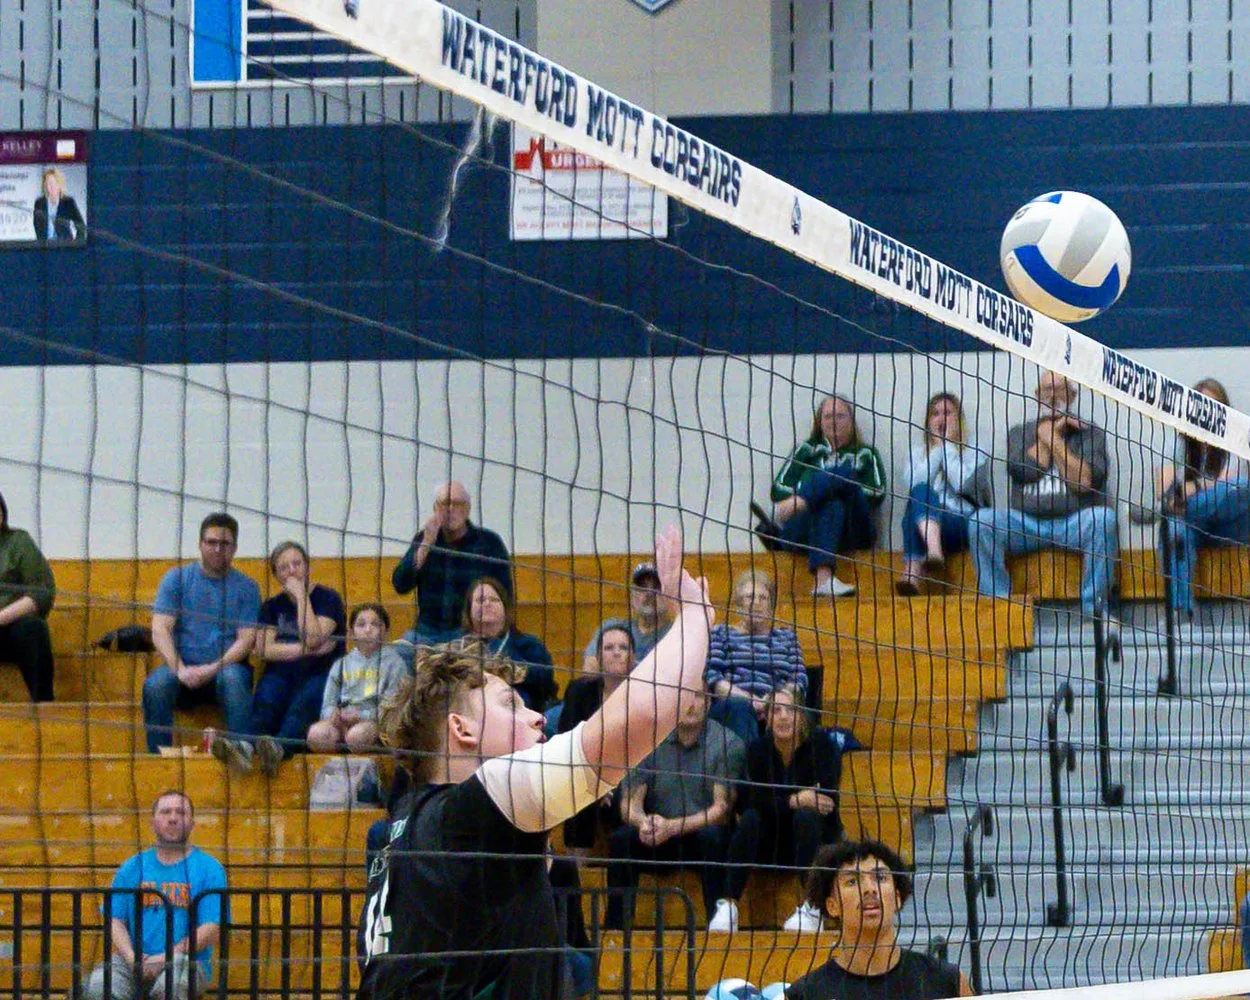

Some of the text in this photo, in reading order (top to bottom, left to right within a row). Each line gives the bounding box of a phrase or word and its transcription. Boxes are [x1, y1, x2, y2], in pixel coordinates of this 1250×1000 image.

[442, 7, 742, 207] WATERFORD MOTT CORSAIRS
[848, 218, 1034, 348] WATERFORD MOTT CORSAIRS
